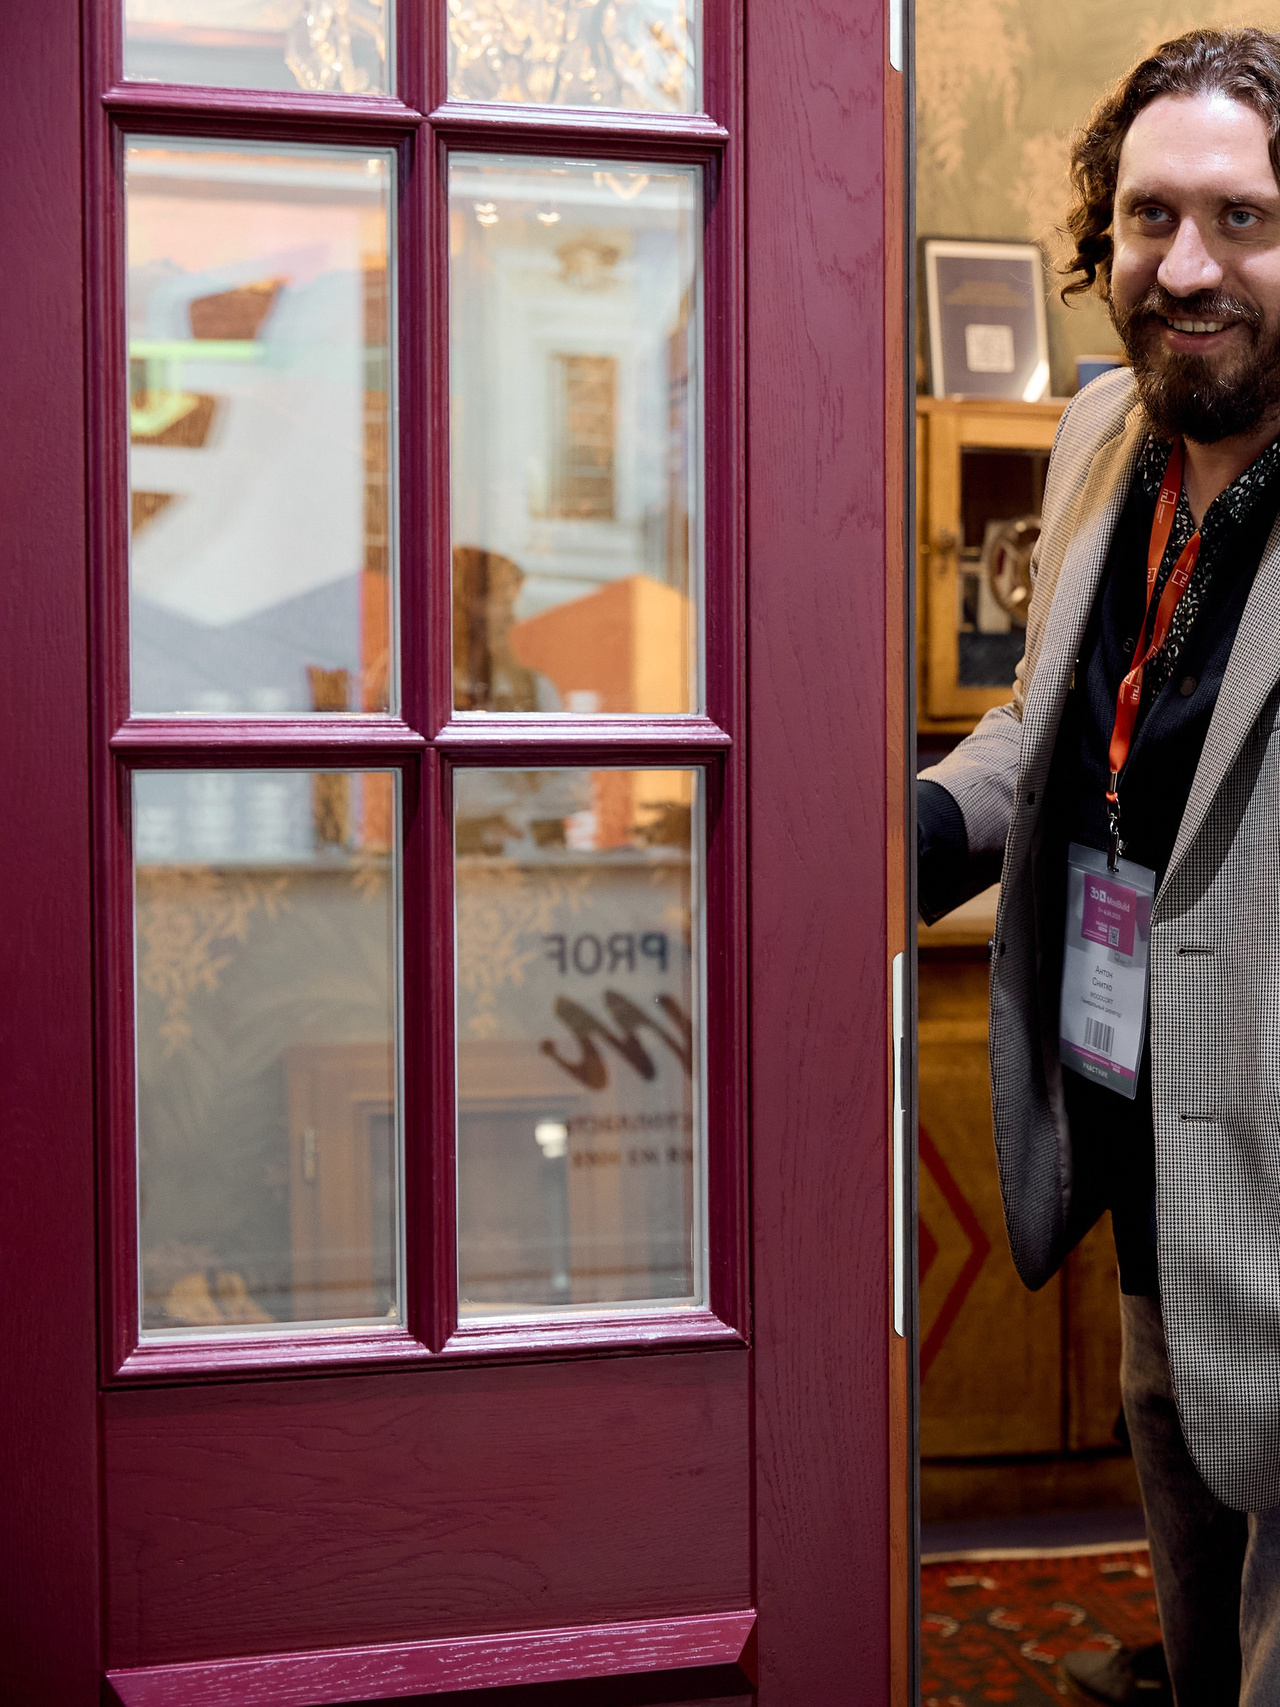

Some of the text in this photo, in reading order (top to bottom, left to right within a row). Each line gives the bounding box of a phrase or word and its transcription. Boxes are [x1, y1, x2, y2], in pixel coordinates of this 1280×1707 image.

[1107, 897, 1130, 912] MosBuild
[1095, 965, 1113, 979] Антон
[1092, 977, 1113, 992] Снитко
[1082, 1062, 1108, 1078] УЧАСТНИК
